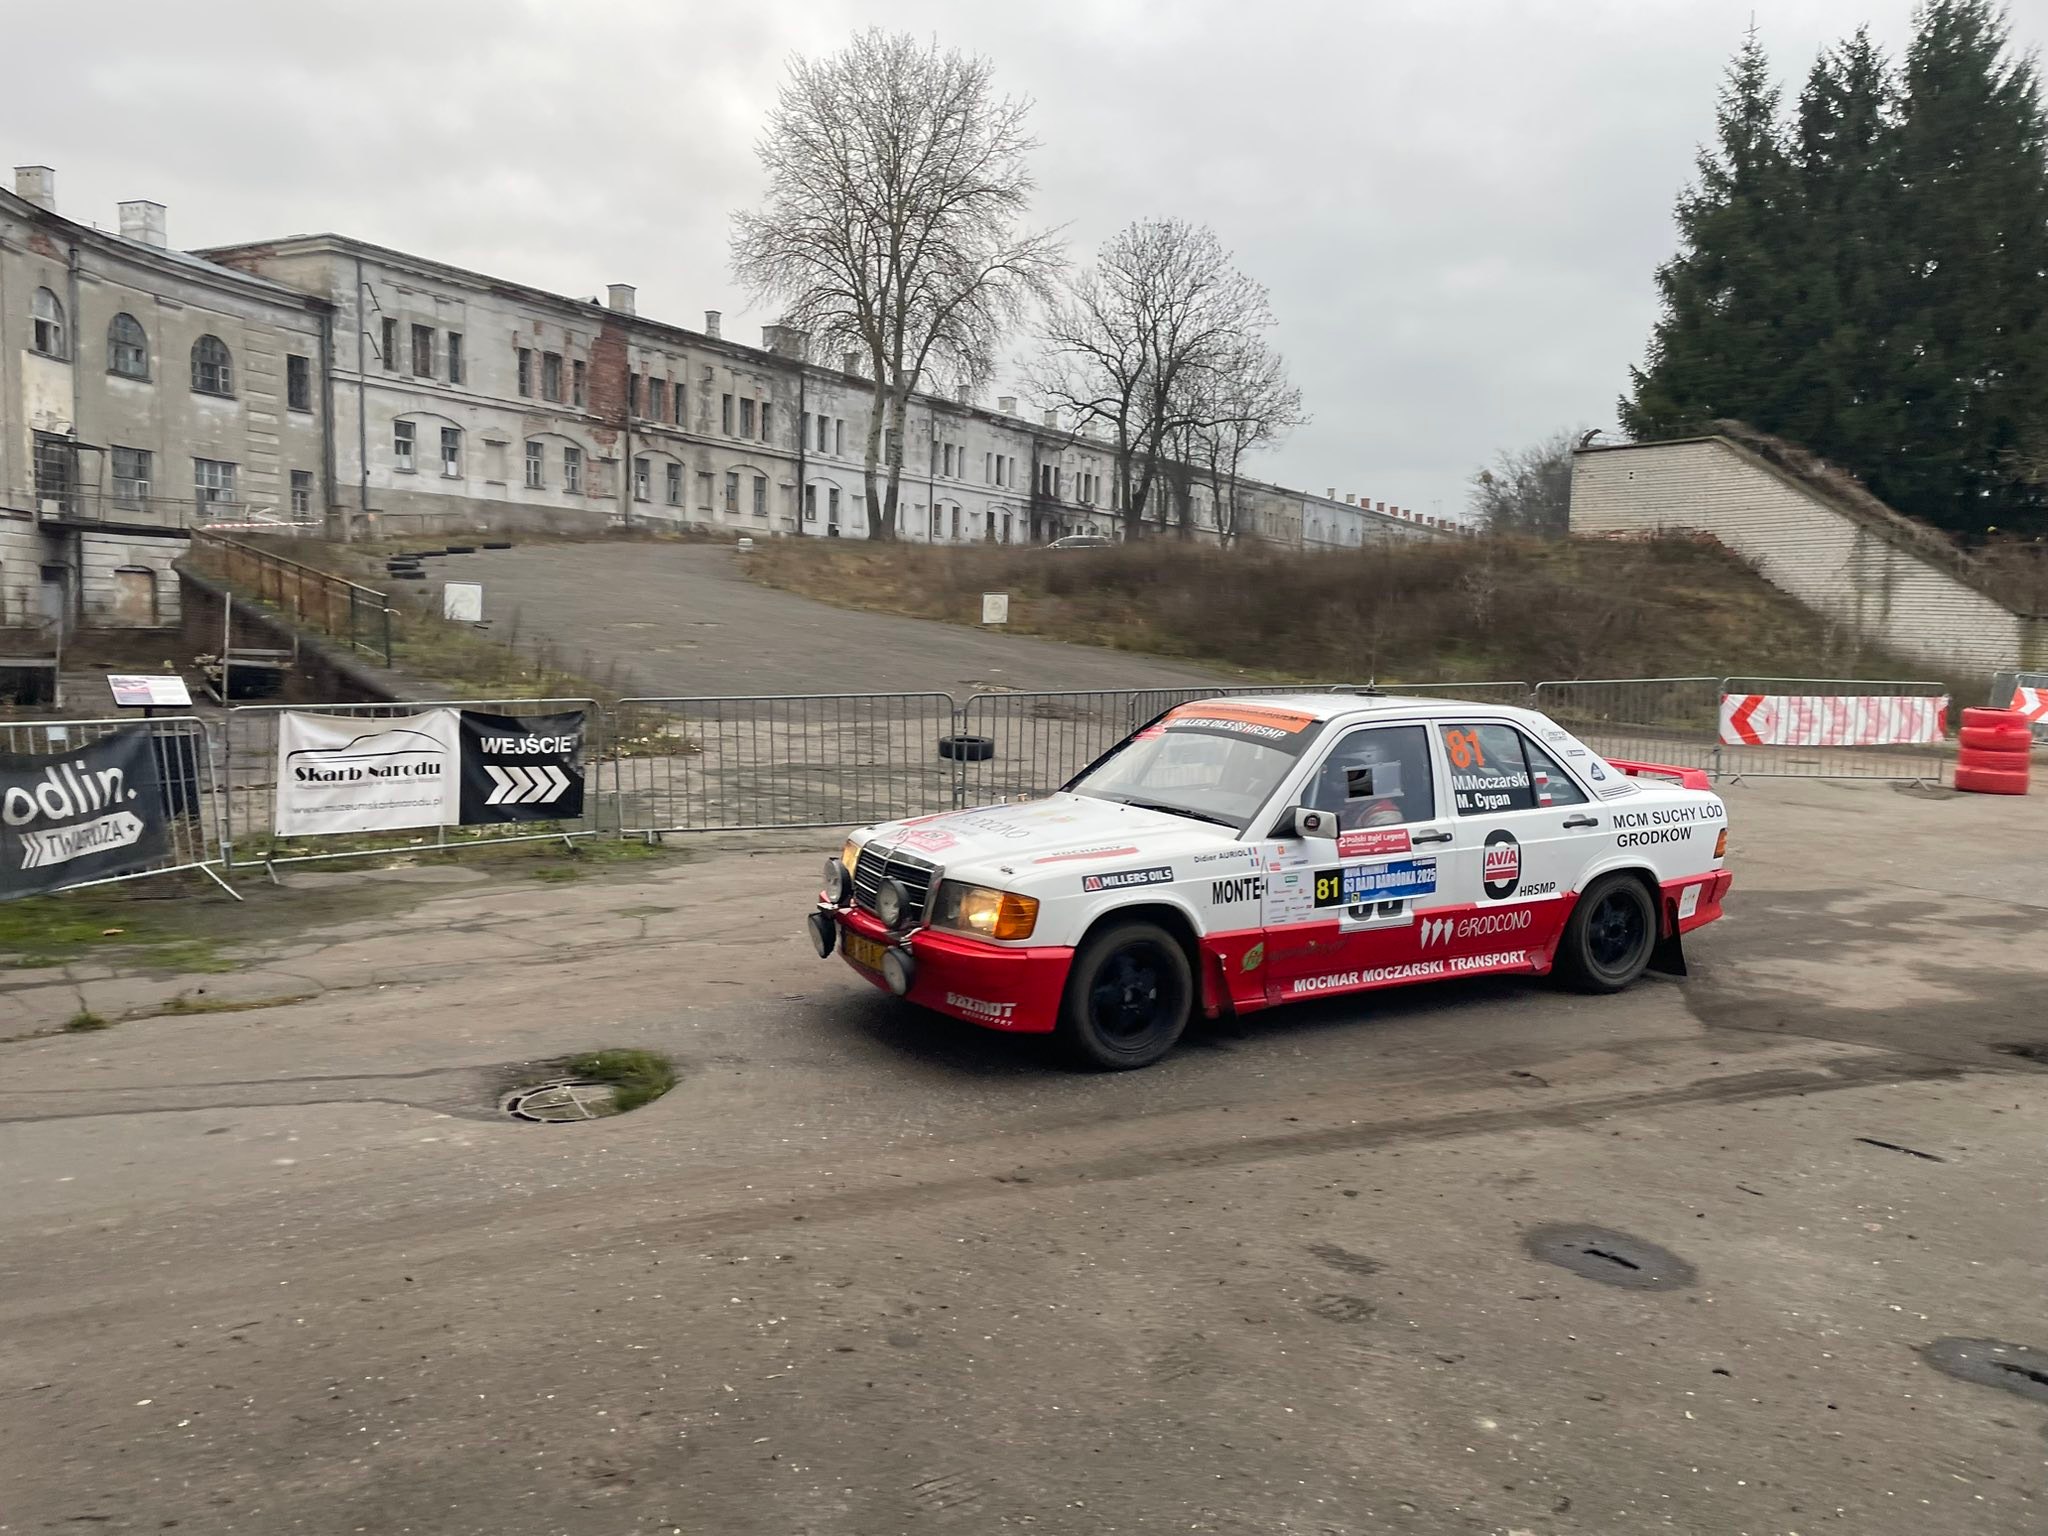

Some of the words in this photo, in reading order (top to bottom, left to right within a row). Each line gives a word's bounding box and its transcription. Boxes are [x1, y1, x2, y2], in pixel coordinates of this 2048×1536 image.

[1211, 720, 1234, 732] OILS
[1243, 724, 1288, 739] HRSMP
[481, 733, 572, 754] WEJŚCIE
[1446, 729, 1486, 769] 81
[295, 766, 363, 782] Skarb
[368, 762, 441, 778] Narodu
[1453, 772, 1530, 791] M.Moczarski
[1457, 794, 1473, 809] M.
[1476, 792, 1511, 810] Cygan
[1613, 812, 1649, 829] MCM
[1652, 807, 1696, 825] SUCHY
[1382, 832, 1406, 842] Legend
[1617, 825, 1692, 848] GRODKÓW
[1219, 849, 1248, 859] AURIOL
[1486, 847, 1518, 867] AVIA
[1102, 873, 1148, 887] MILLERS
[1150, 869, 1173, 882] OILS
[1416, 867, 1436, 884] 2025
[1212, 877, 1269, 905] MONTE-
[1316, 876, 1339, 900] 81
[1520, 881, 1556, 897] HRSMP
[1457, 910, 1532, 938] GRODCONO
[1294, 971, 1359, 992] MOCMAR
[1362, 960, 1444, 983] MOCZARSKI
[1449, 950, 1526, 971] TRANSPORT
